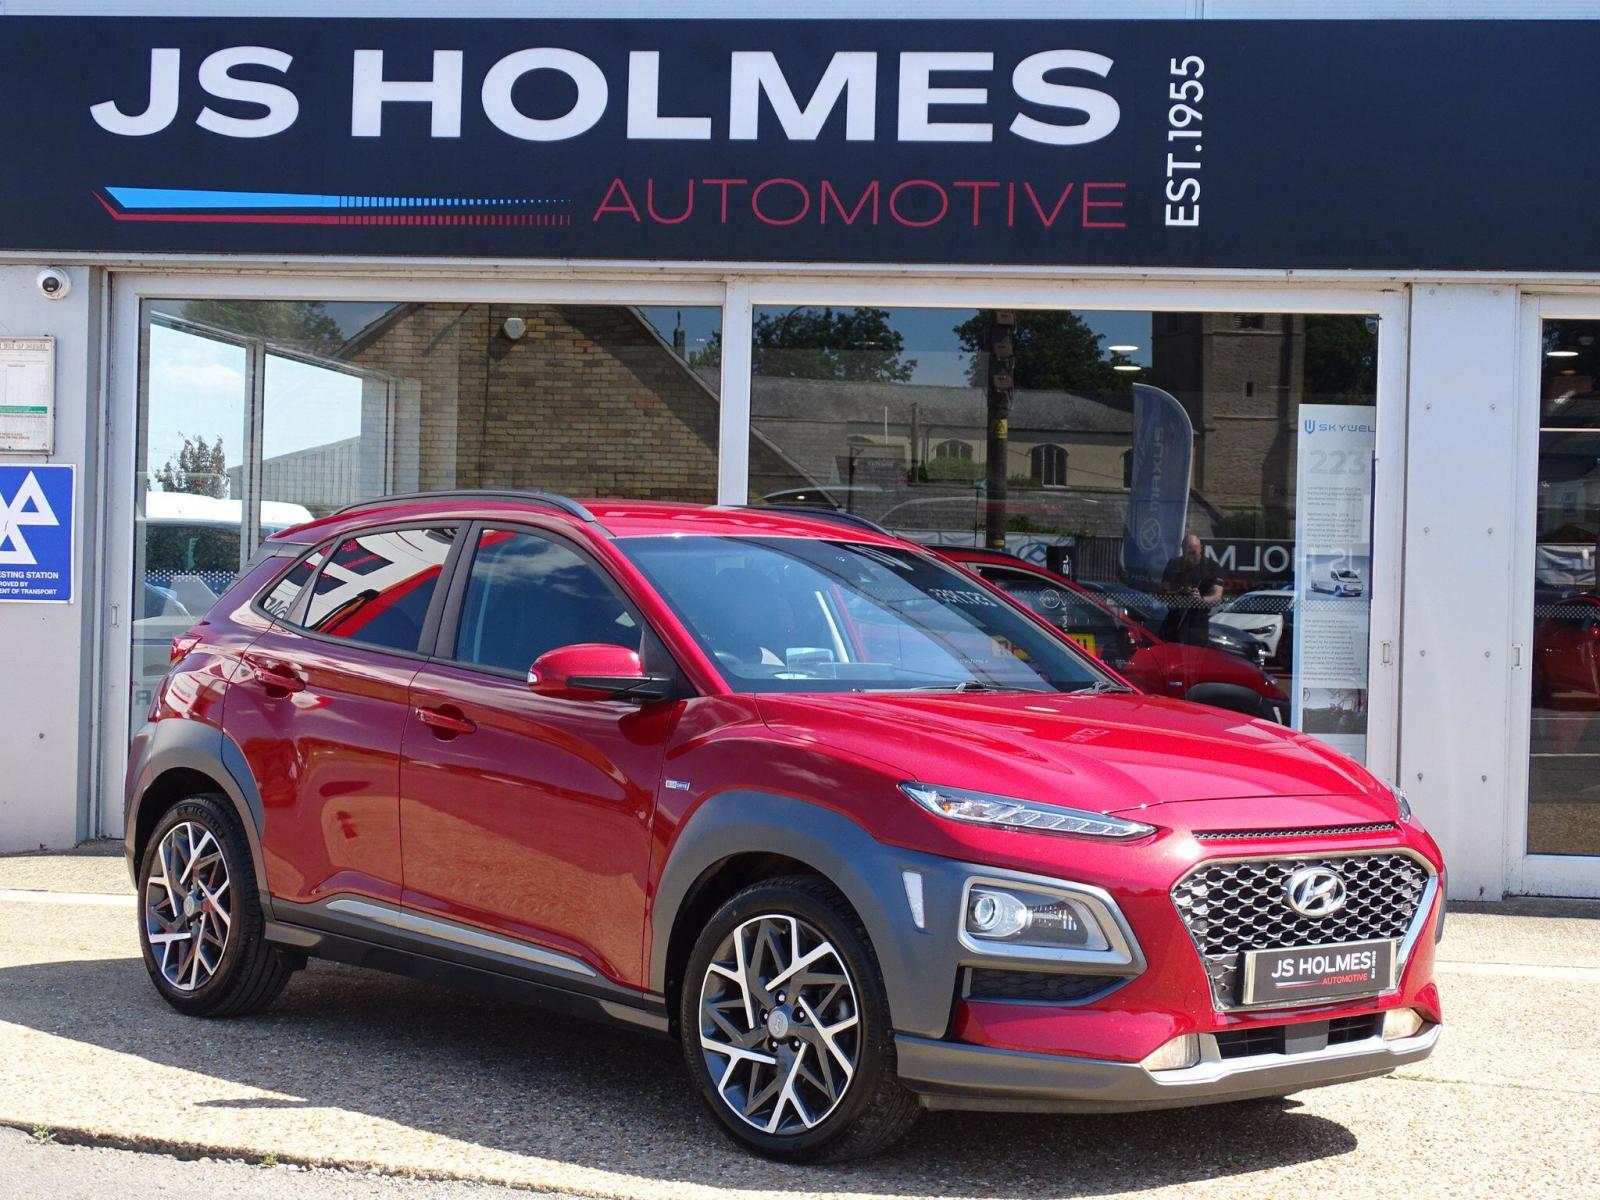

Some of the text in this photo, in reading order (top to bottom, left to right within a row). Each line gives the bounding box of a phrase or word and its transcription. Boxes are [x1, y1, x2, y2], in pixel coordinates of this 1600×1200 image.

[89, 45, 1121, 145] JS HOLMES
[1165, 54, 1206, 228] EST.1955
[592, 177, 1127, 228] AUTOMOTIVE
[1309, 449, 1366, 475] 223
[1271, 958, 1295, 979] JS
[1299, 951, 1371, 976] HOLMES
[1321, 972, 1368, 985] AUTOMOTIVE
